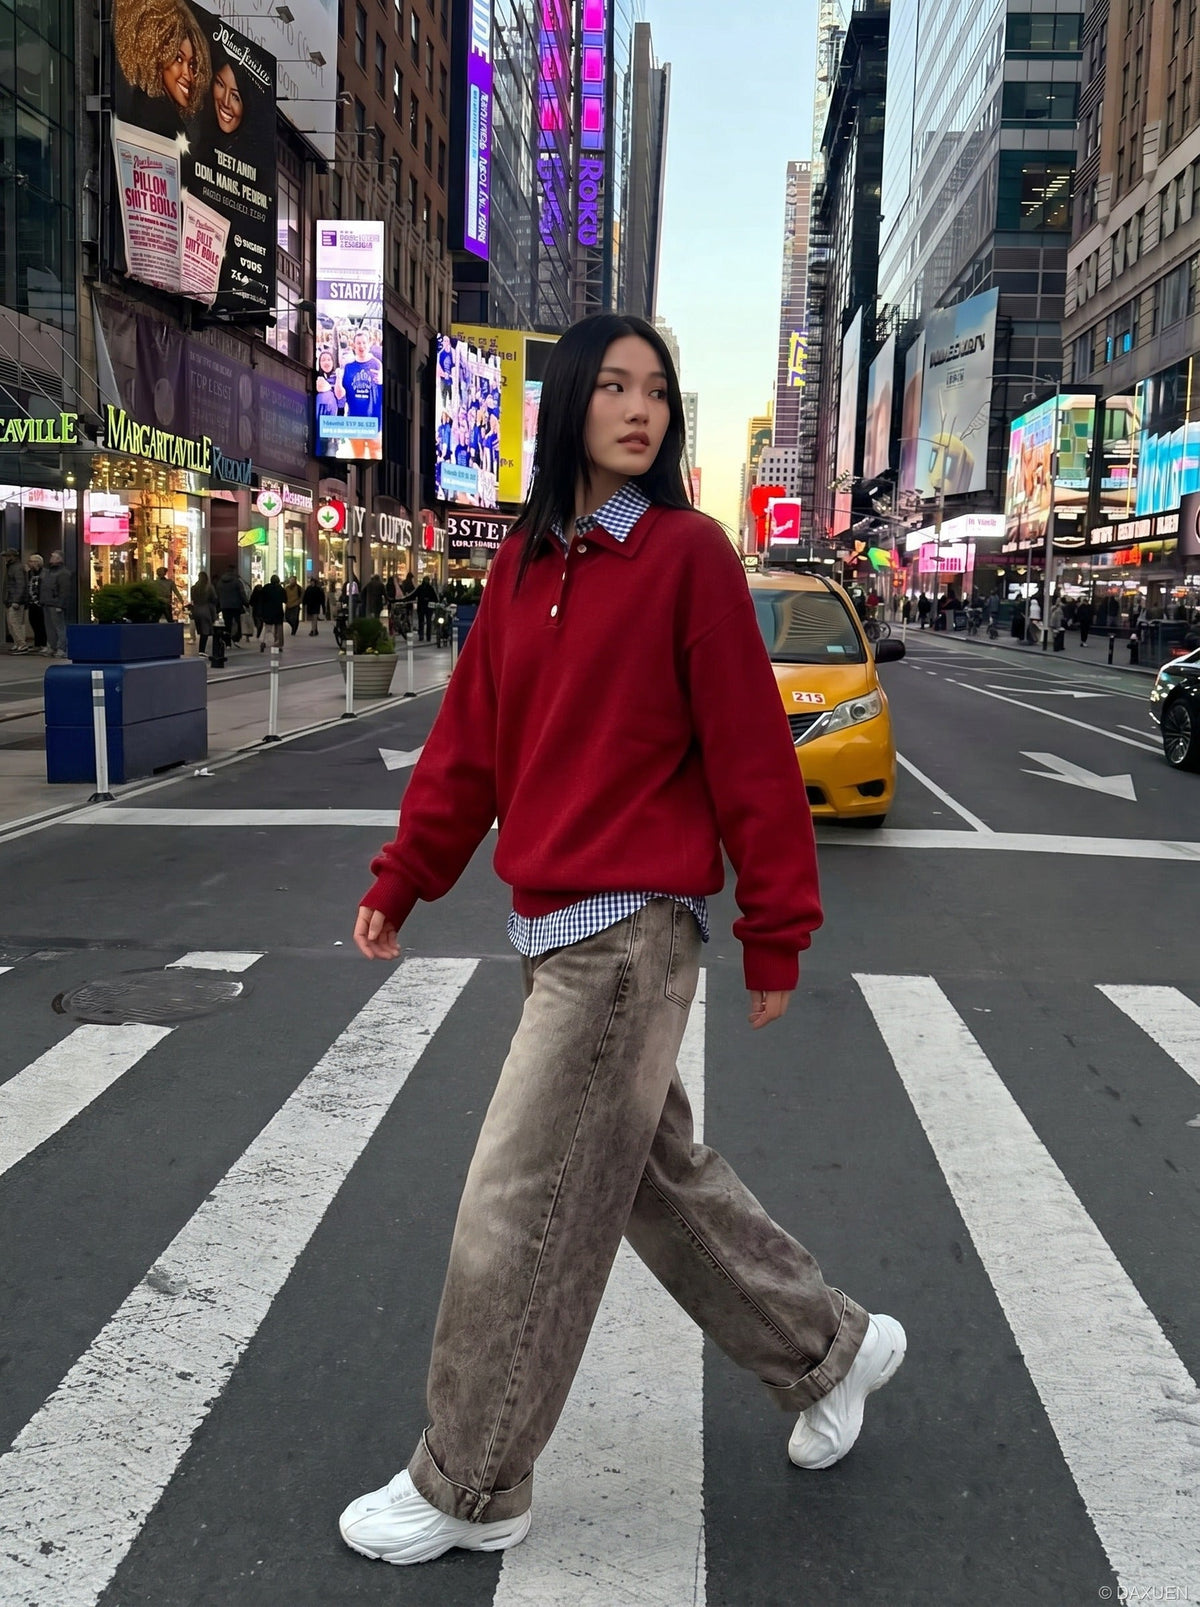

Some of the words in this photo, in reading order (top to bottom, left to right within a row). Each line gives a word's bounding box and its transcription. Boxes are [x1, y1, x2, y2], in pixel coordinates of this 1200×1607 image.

[472, 0, 490, 64] IDE
[578, 158, 604, 246] ROKU
[795, 693, 823, 703] 215
